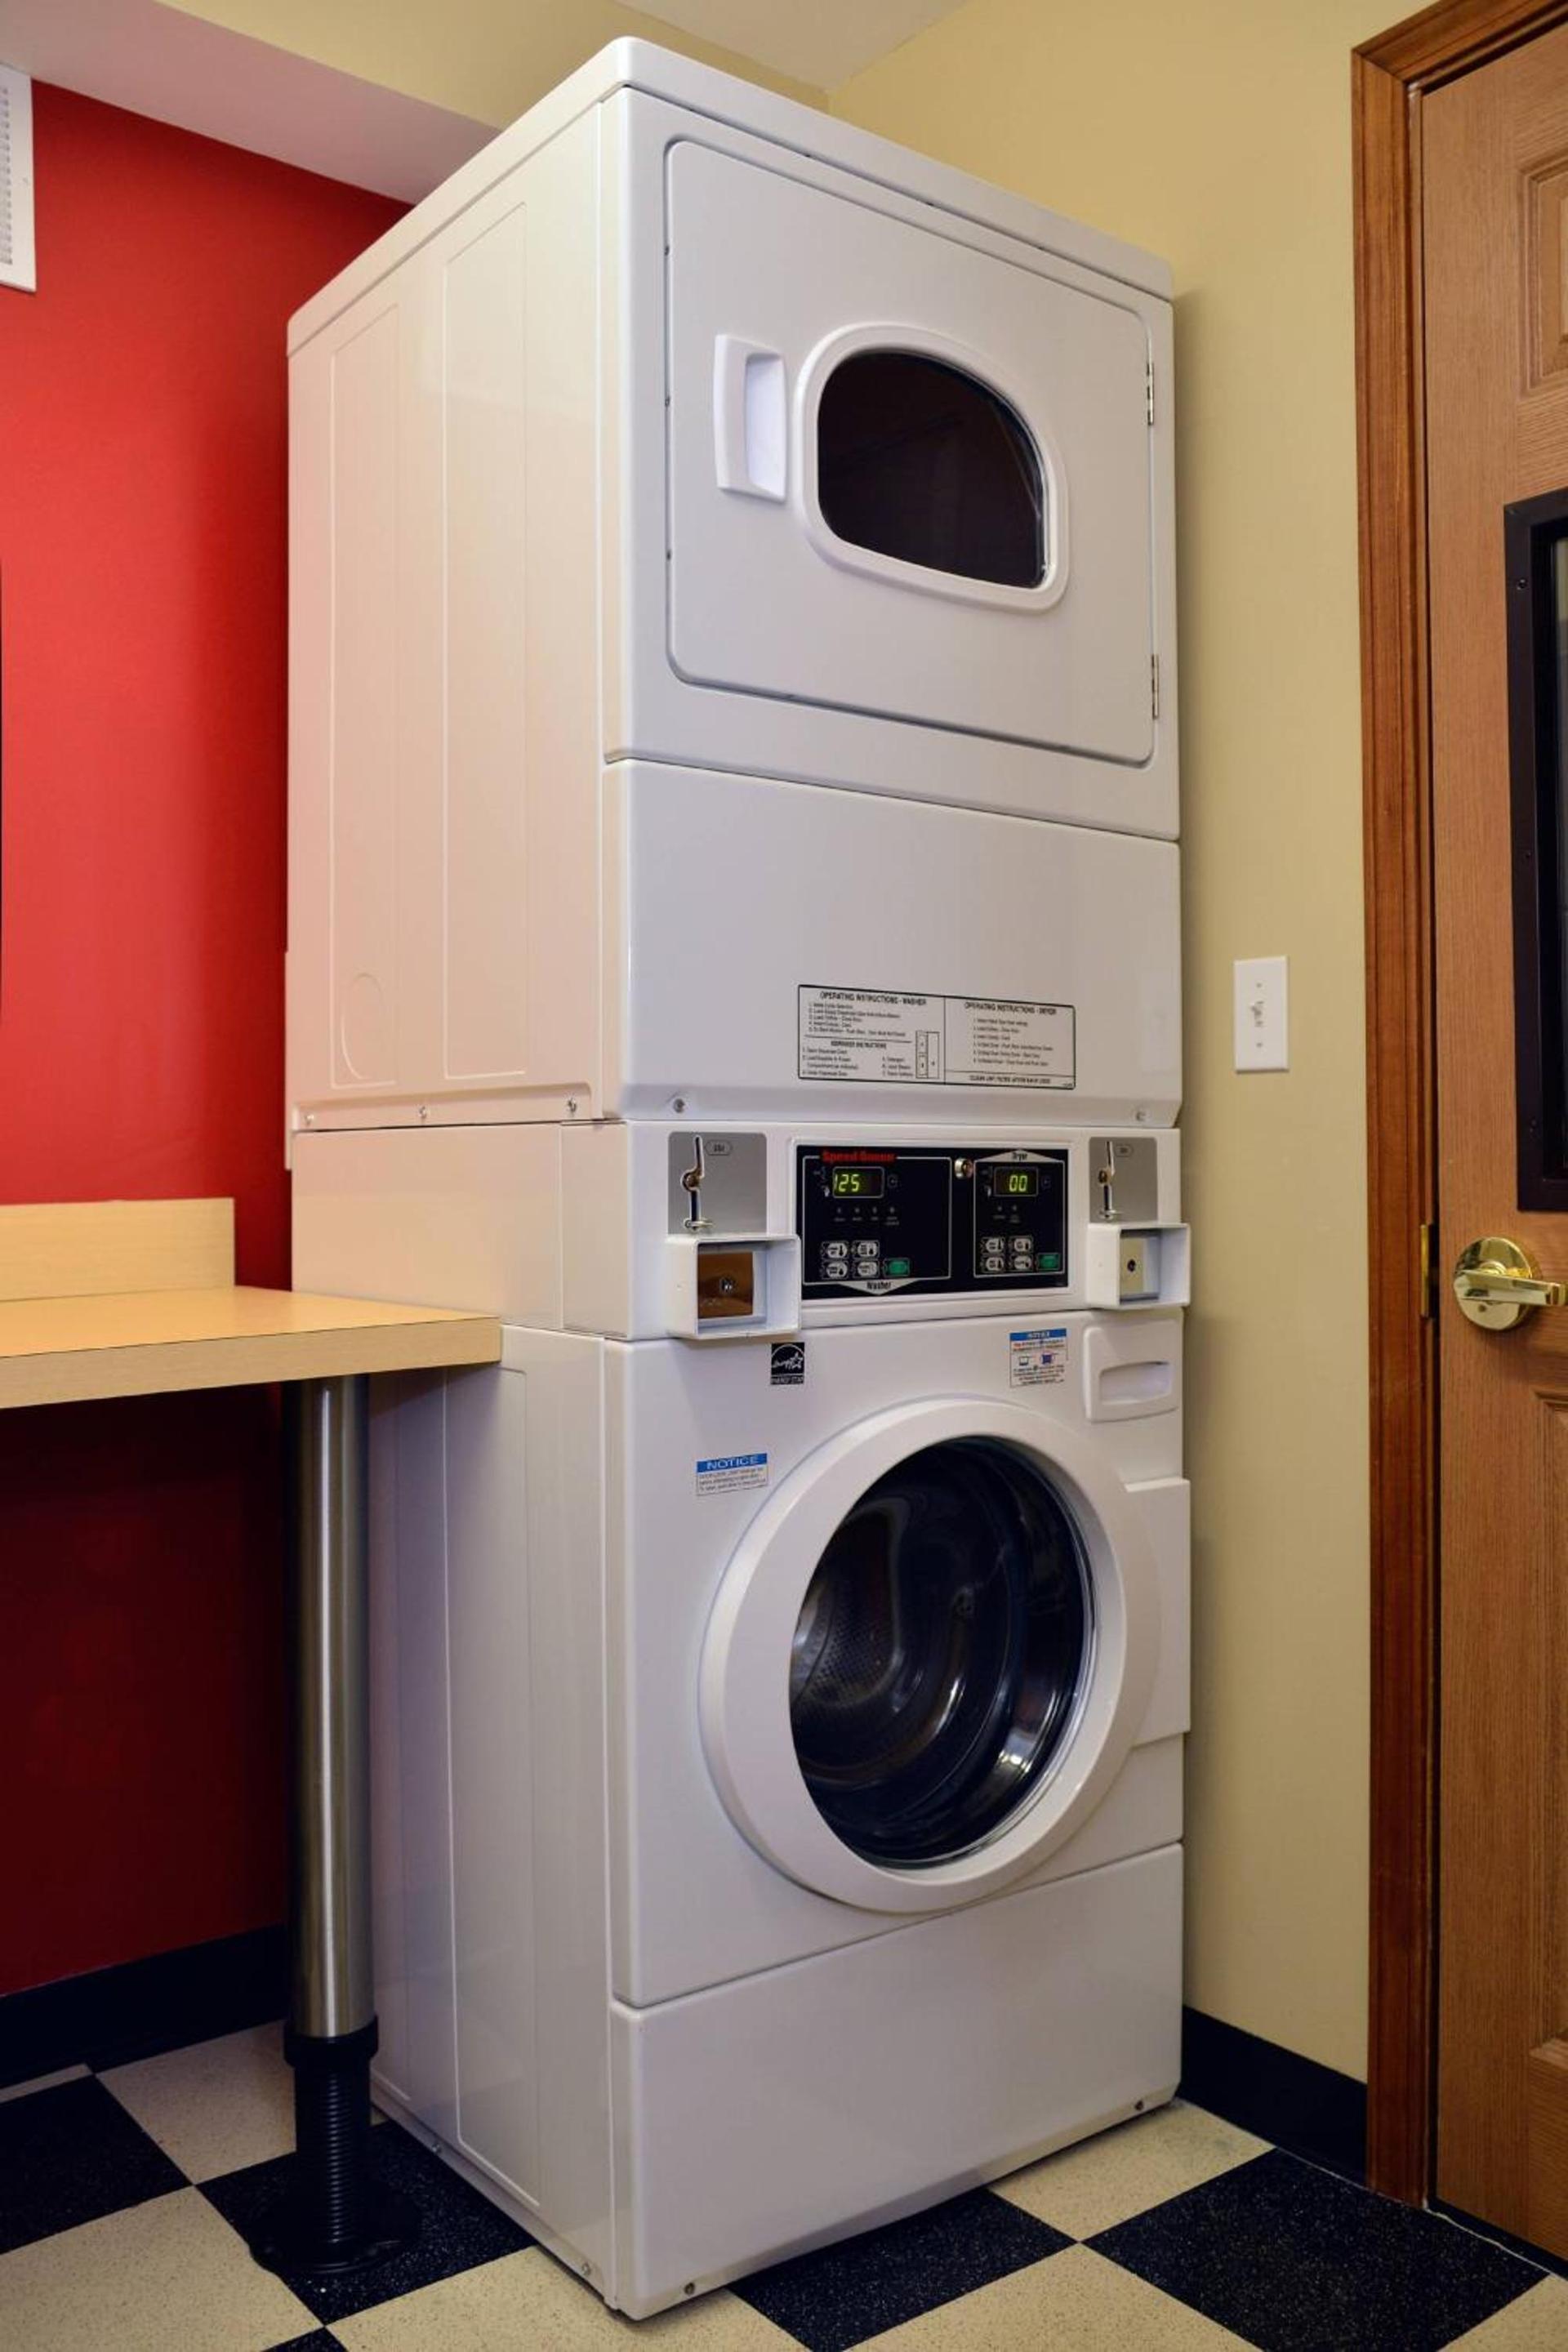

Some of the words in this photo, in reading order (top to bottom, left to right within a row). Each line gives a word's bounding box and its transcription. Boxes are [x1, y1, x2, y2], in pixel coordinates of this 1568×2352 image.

[820, 991, 855, 1001] OPERATING
[857, 994, 898, 1004] INSTRUCTIONS
[964, 1001, 996, 1011] OPERATING
[997, 1004, 1036, 1014] INSTRUCTIONS
[1009, 1174, 1028, 1192] 00
[866, 1281, 892, 1290] Washer
[707, 1456, 758, 1470] NOTICE
